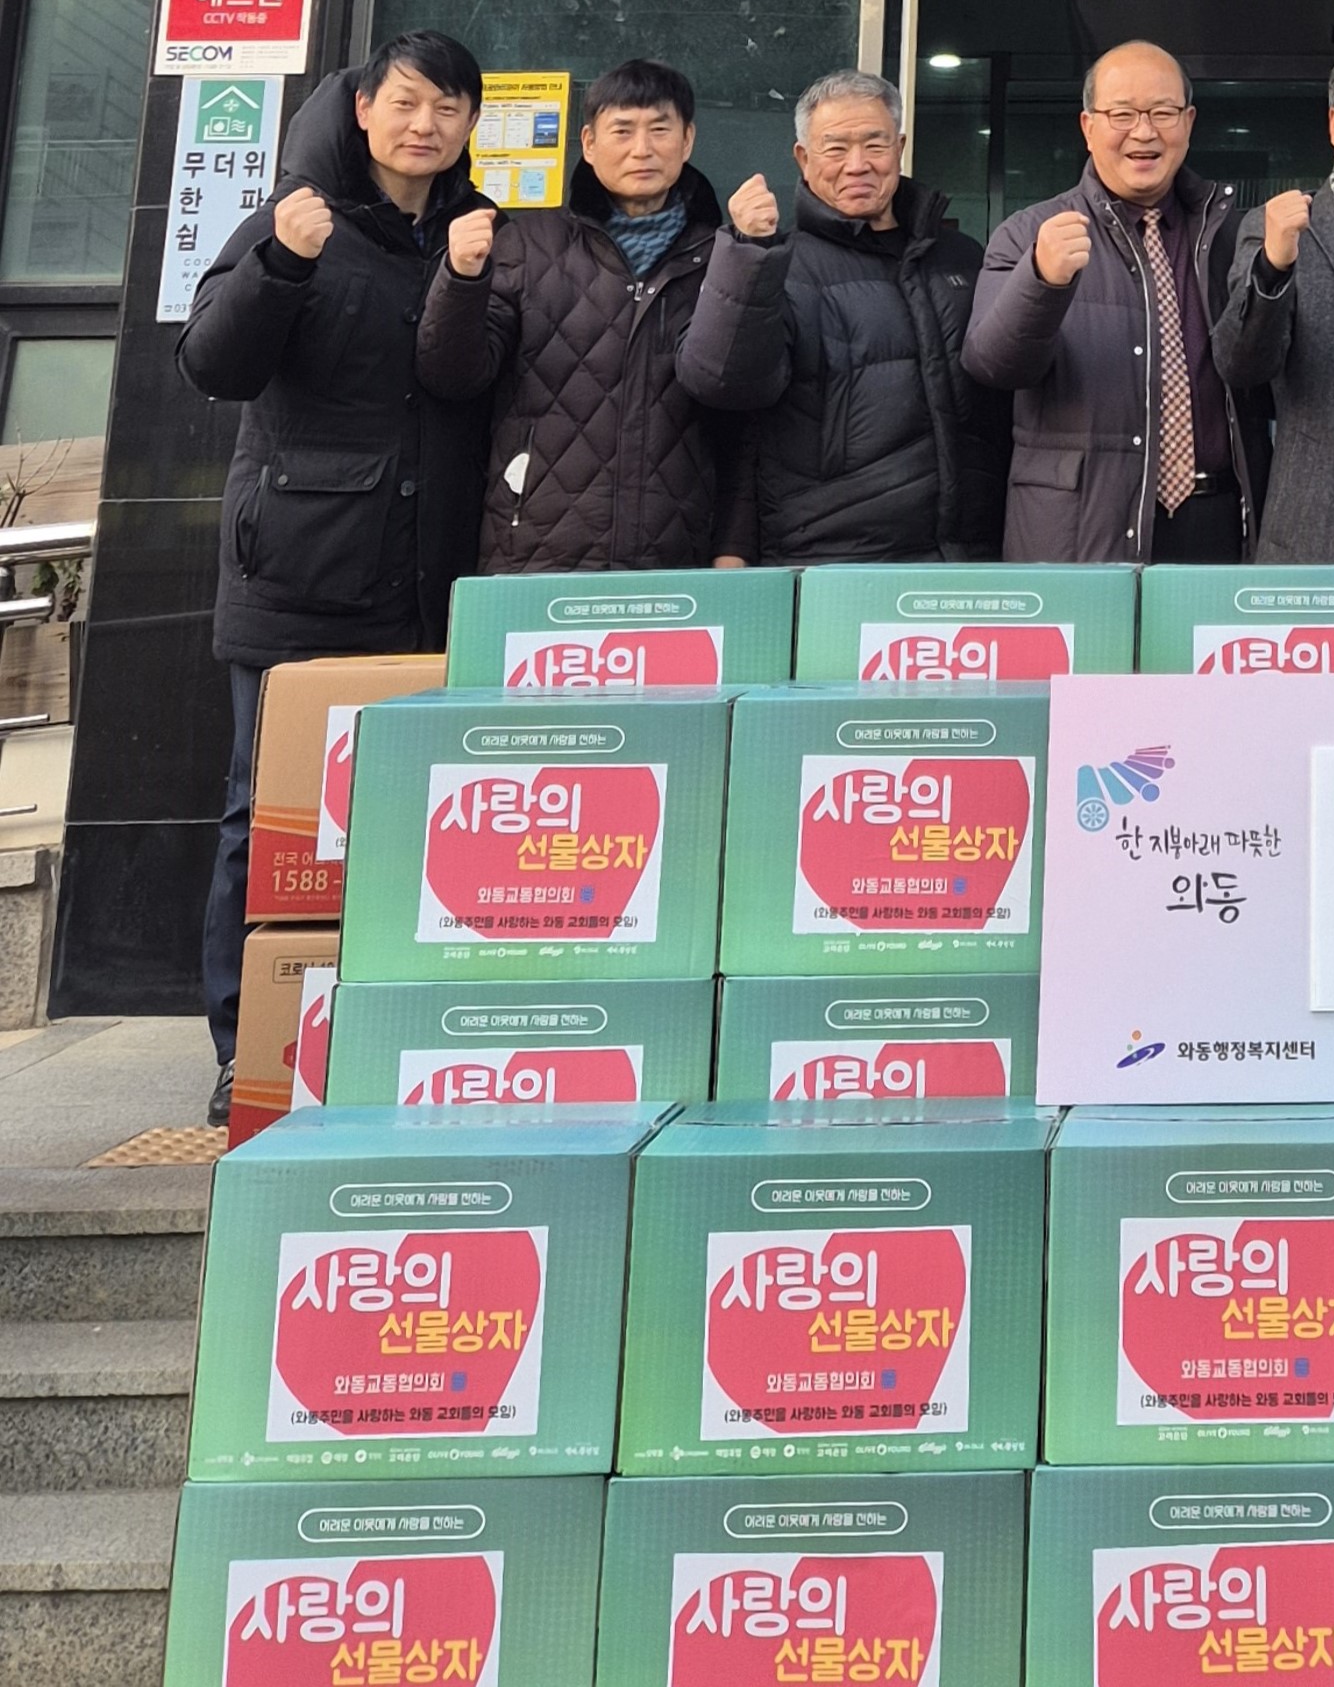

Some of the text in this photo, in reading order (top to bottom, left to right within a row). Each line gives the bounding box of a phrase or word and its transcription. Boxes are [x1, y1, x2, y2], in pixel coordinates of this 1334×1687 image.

[203, 12, 235, 24] CCTV
[166, 46, 233, 61] SECOM
[440, 783, 582, 833] 사랑의
[812, 775, 952, 825] 사랑의
[274, 852, 298, 866] 전국
[517, 835, 648, 871] 선물상자
[890, 825, 1019, 862] 선물상자
[1151, 825, 1222, 860] 지붕아래
[1227, 824, 1282, 858] 따뜻한
[1166, 872, 1247, 924] 와동
[1177, 1039, 1316, 1061] 와동행정복지센터
[291, 1252, 452, 1312] 사랑의
[721, 1250, 878, 1311] 사랑의
[1135, 1238, 1288, 1297] 사랑의
[379, 1309, 528, 1354] 선물상자
[808, 1307, 954, 1353] 선물상자
[241, 1578, 404, 1644] 사랑의
[686, 1575, 847, 1638] 사랑의
[1109, 1565, 1267, 1631] 사랑의
[331, 1638, 483, 1686] 선물상자
[774, 1637, 925, 1683] 선물상자
